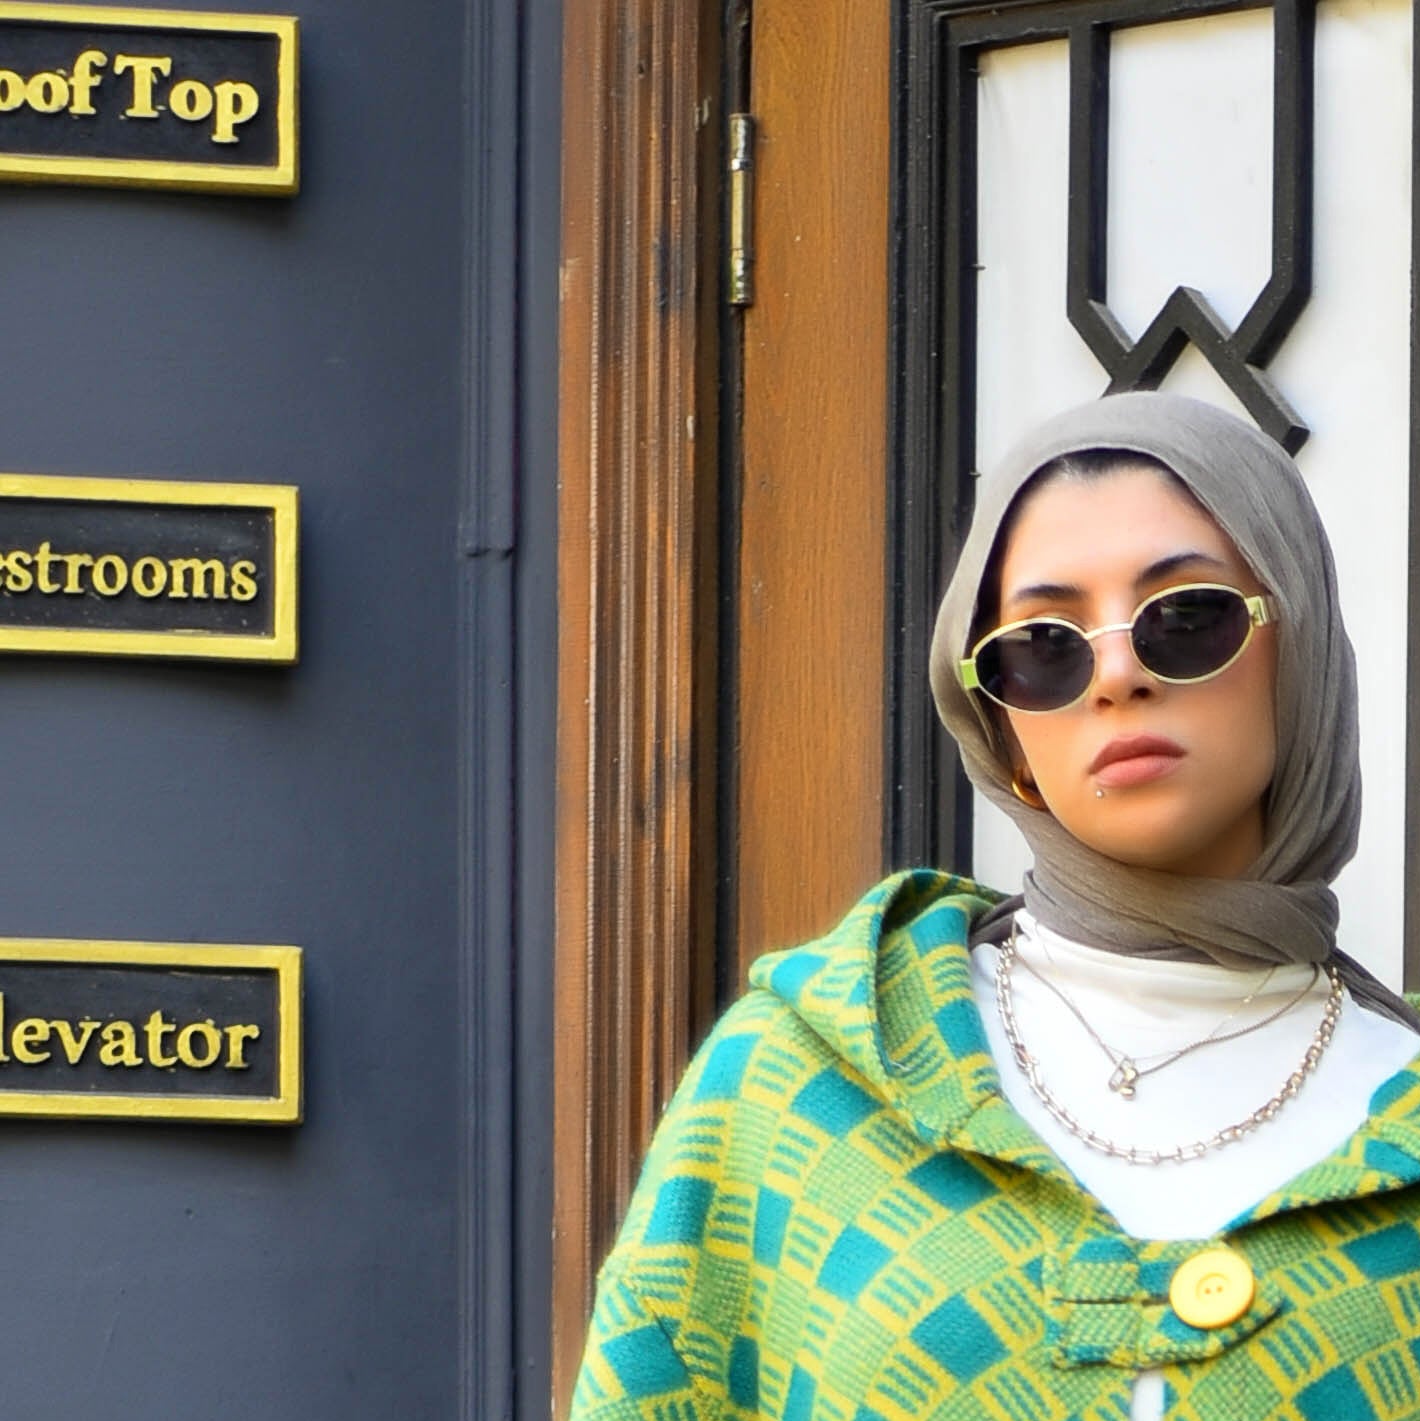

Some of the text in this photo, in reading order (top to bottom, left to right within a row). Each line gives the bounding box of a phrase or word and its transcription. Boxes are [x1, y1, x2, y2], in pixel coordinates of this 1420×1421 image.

[0, 50, 259, 143] oof Top
[0, 541, 257, 601] strooms
